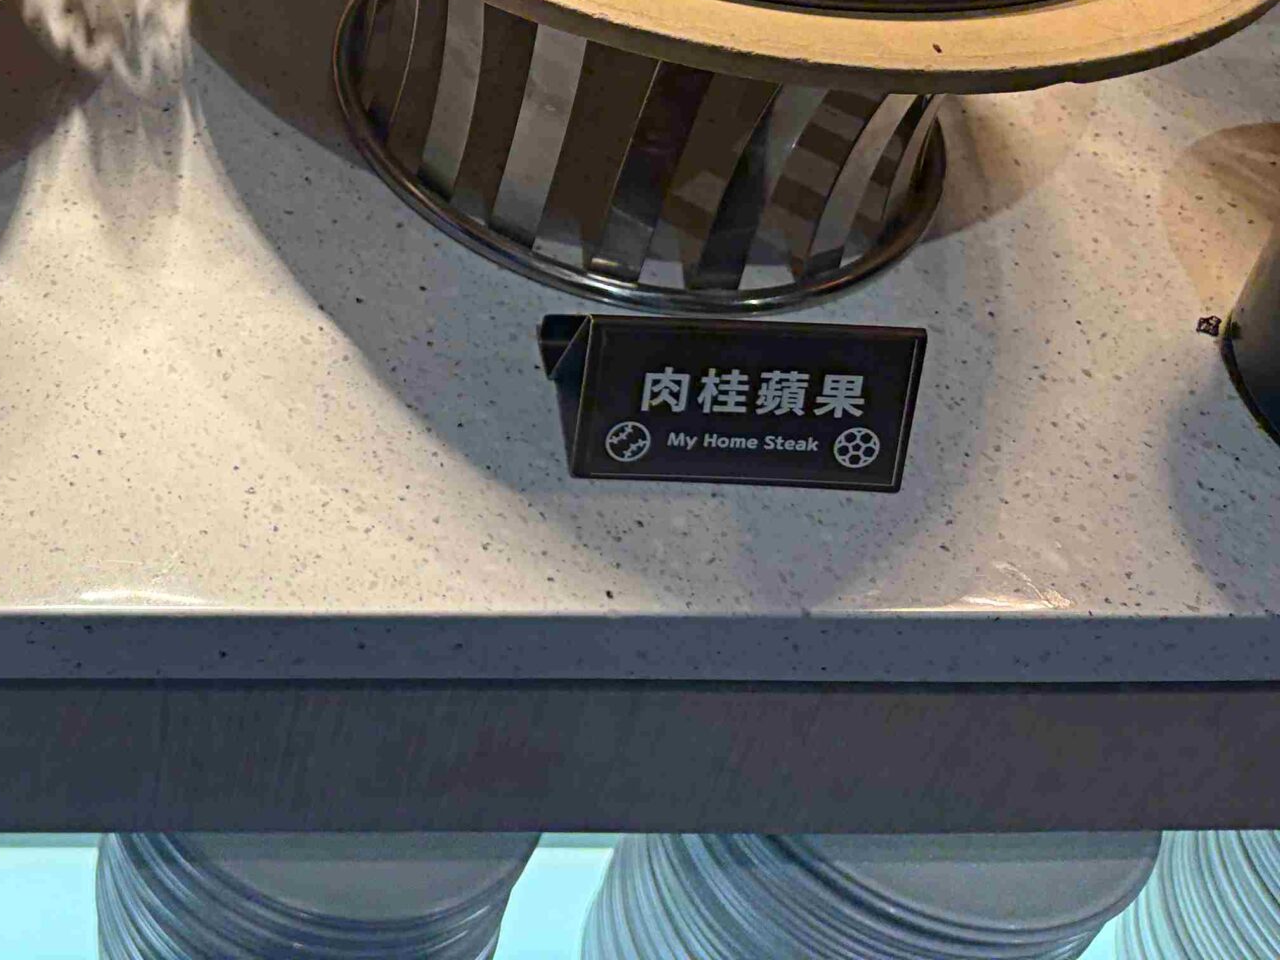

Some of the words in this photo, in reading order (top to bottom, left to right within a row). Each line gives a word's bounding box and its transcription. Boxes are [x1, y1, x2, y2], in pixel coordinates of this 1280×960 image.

[640, 367, 866, 418] 肉桂蘋果
[666, 432, 697, 450] My
[703, 433, 758, 450] Home
[764, 435, 819, 453] Steak
